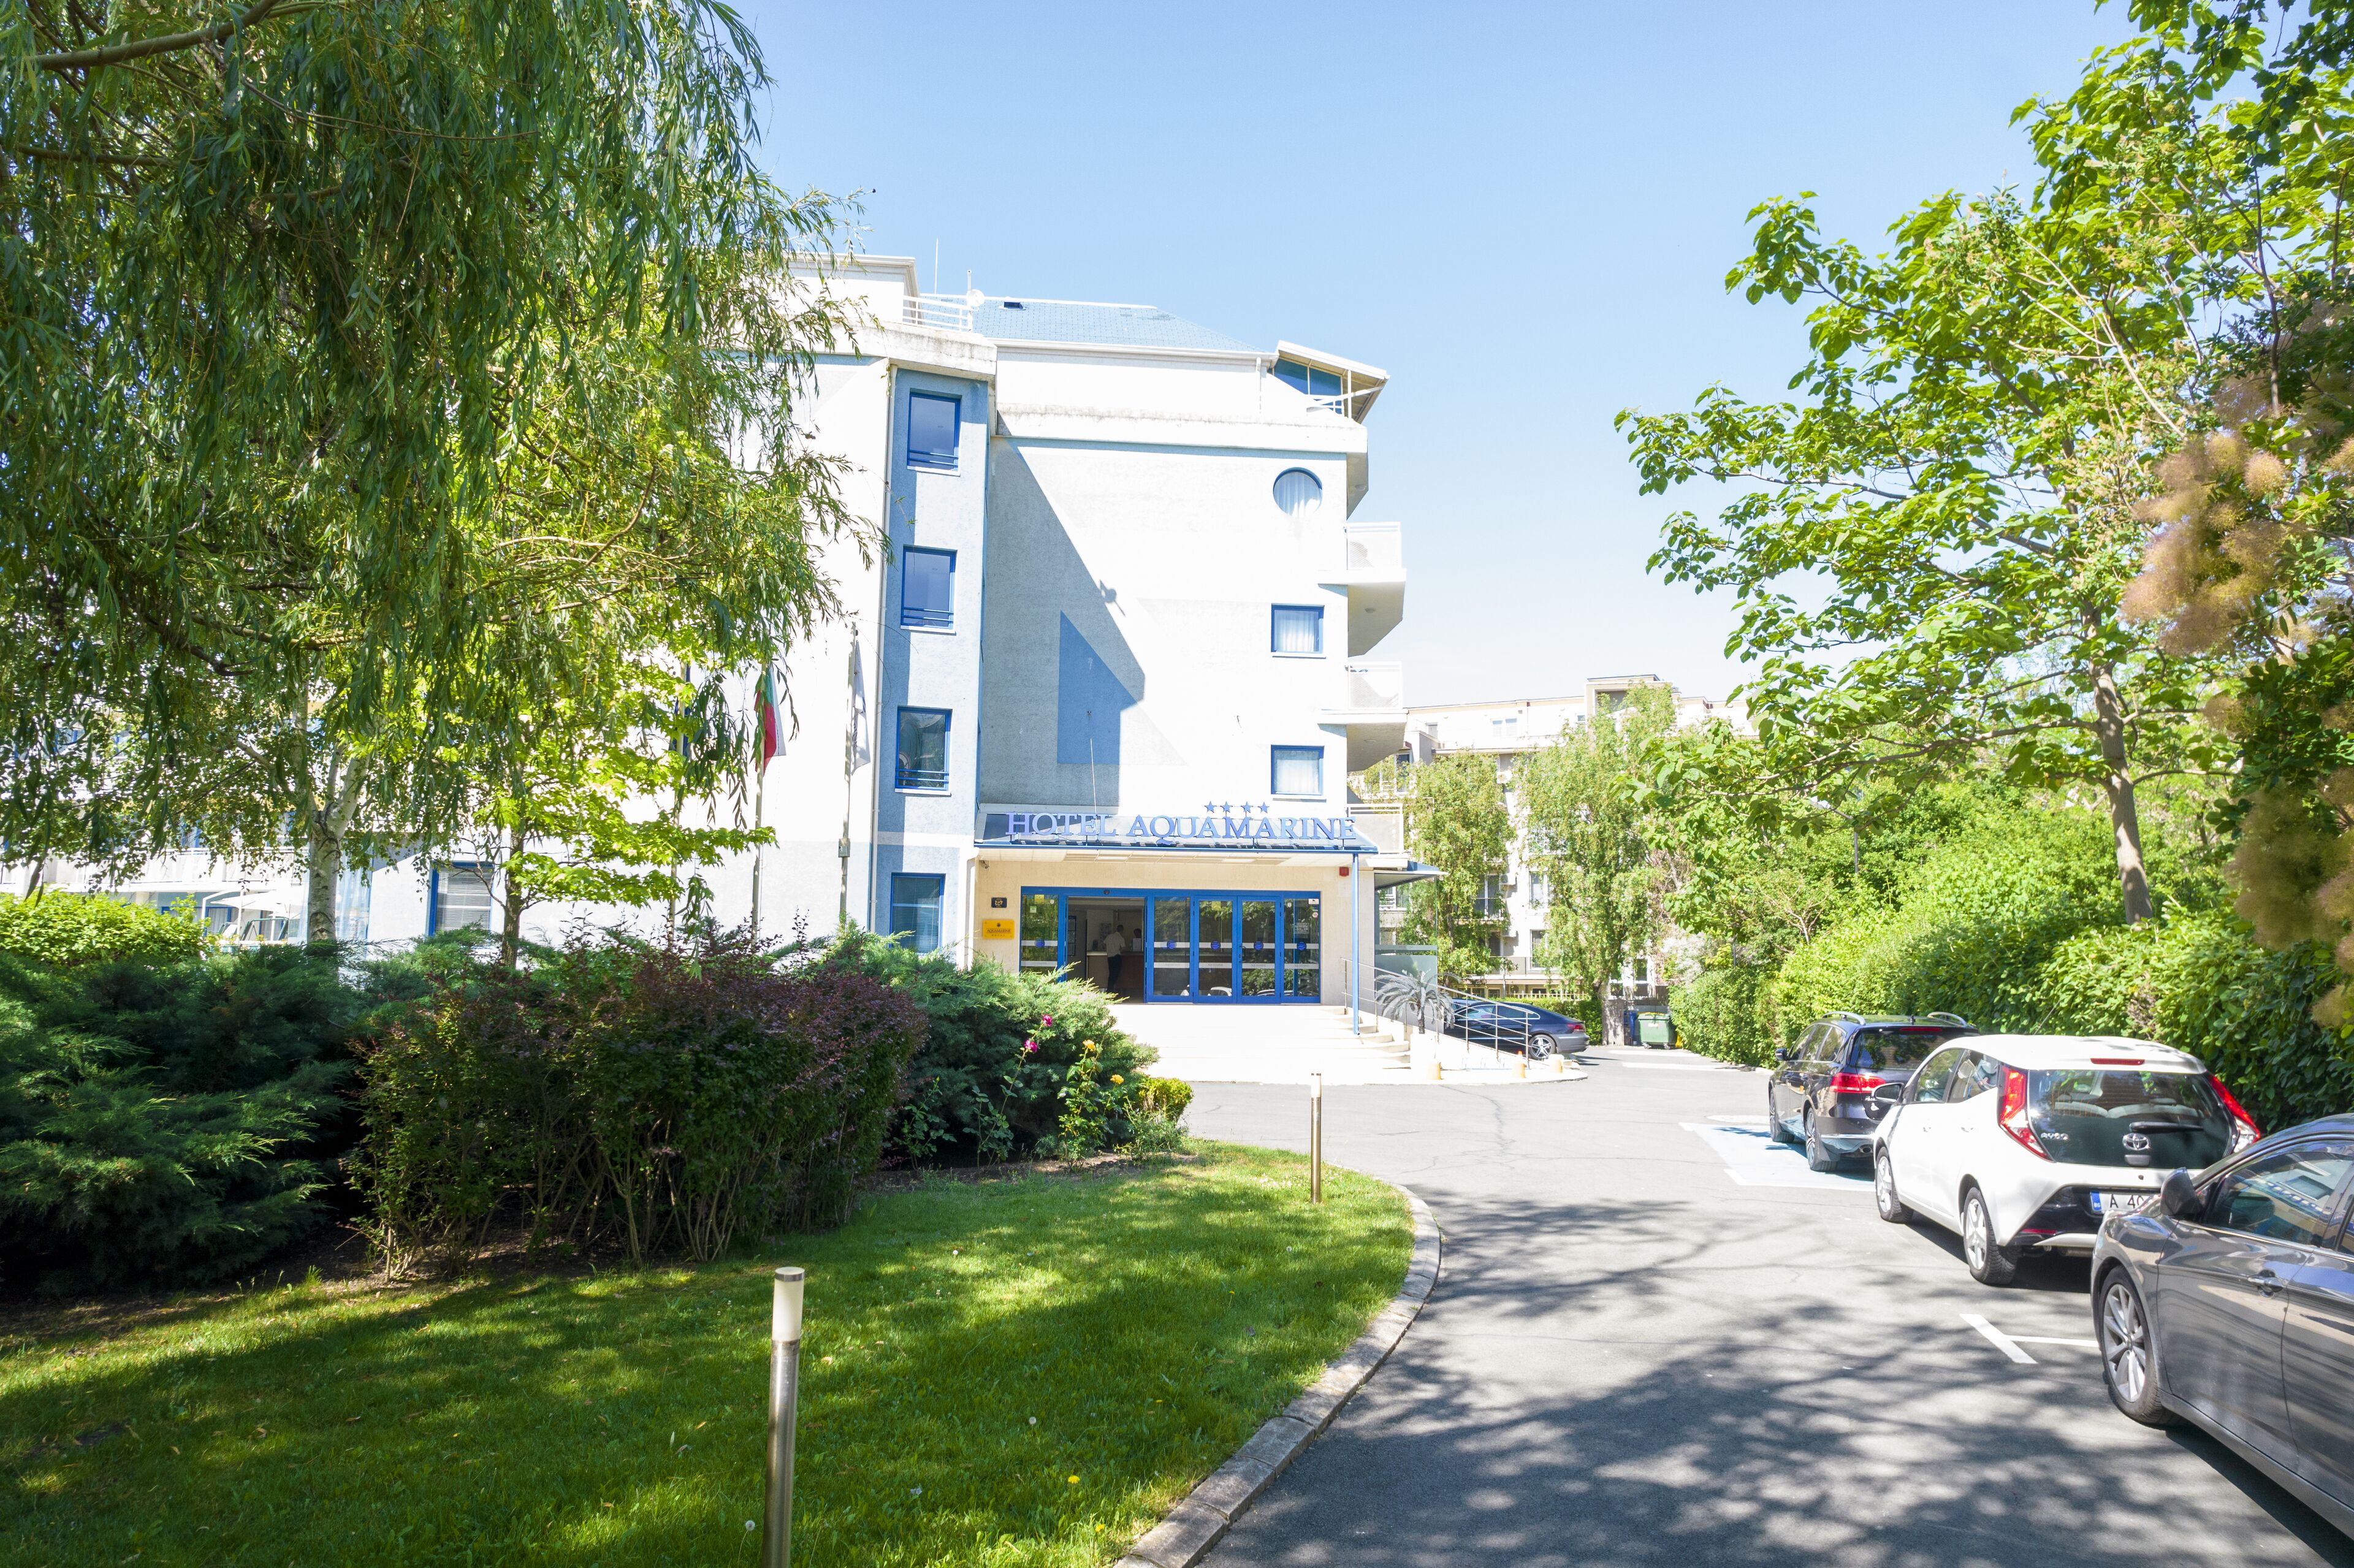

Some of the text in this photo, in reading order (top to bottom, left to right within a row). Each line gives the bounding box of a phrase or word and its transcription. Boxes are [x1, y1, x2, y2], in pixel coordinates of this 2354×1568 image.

[1005, 812, 1357, 845] HOTEL AQUAMARINE
[2110, 1193, 2119, 1208] A
